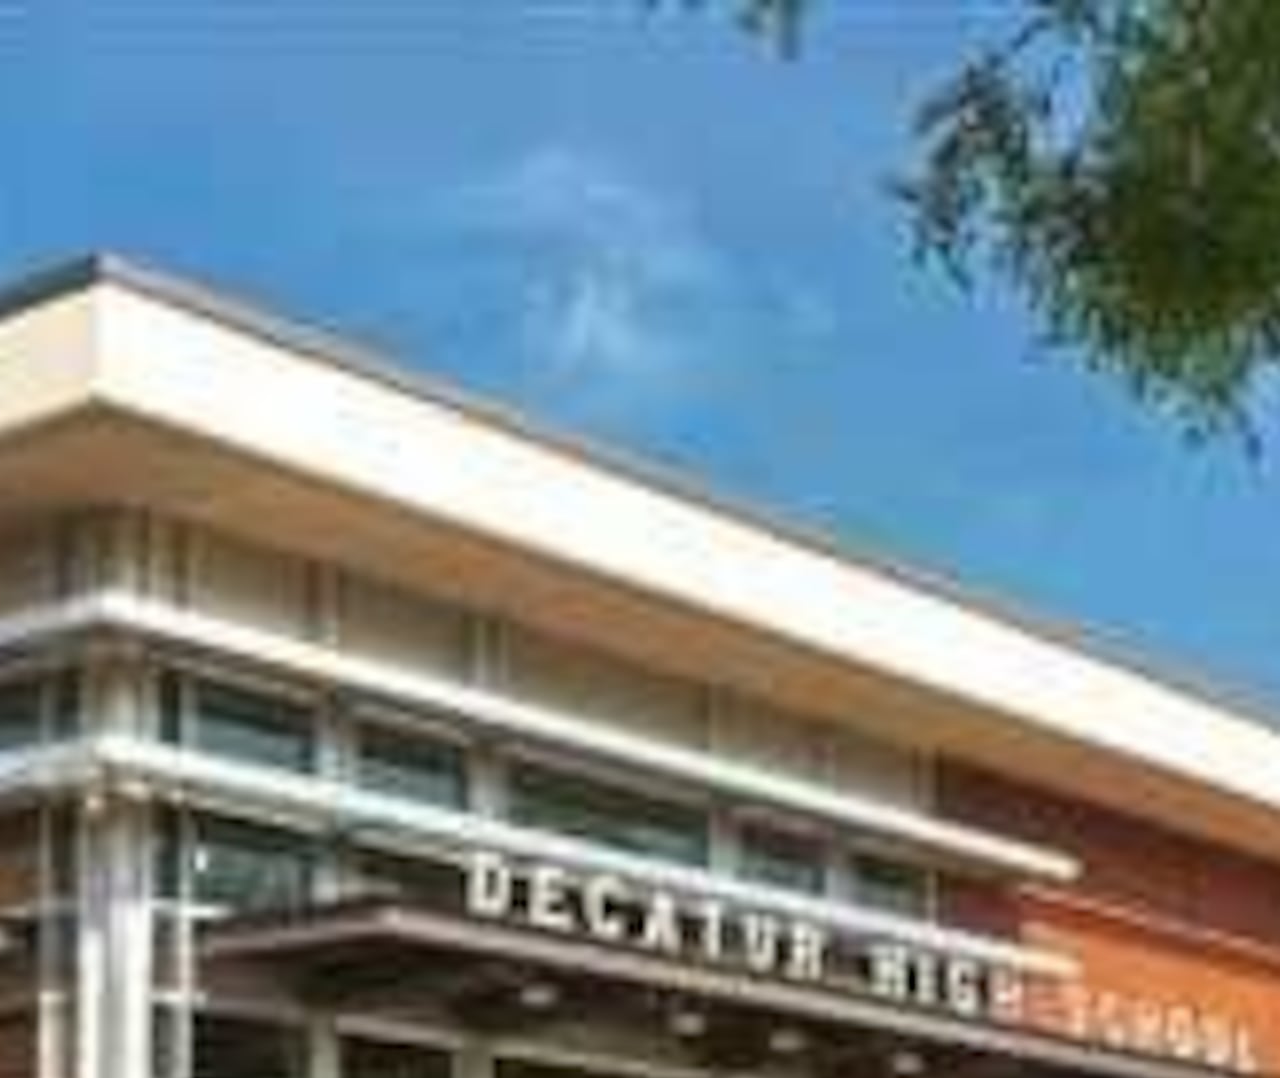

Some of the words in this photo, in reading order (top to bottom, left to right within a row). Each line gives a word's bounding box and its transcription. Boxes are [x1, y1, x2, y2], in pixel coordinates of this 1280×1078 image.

[466, 852, 826, 982] DECATUR
[869, 942, 1021, 1020] HIGH
[1064, 982, 1258, 1074] SCHOOL
